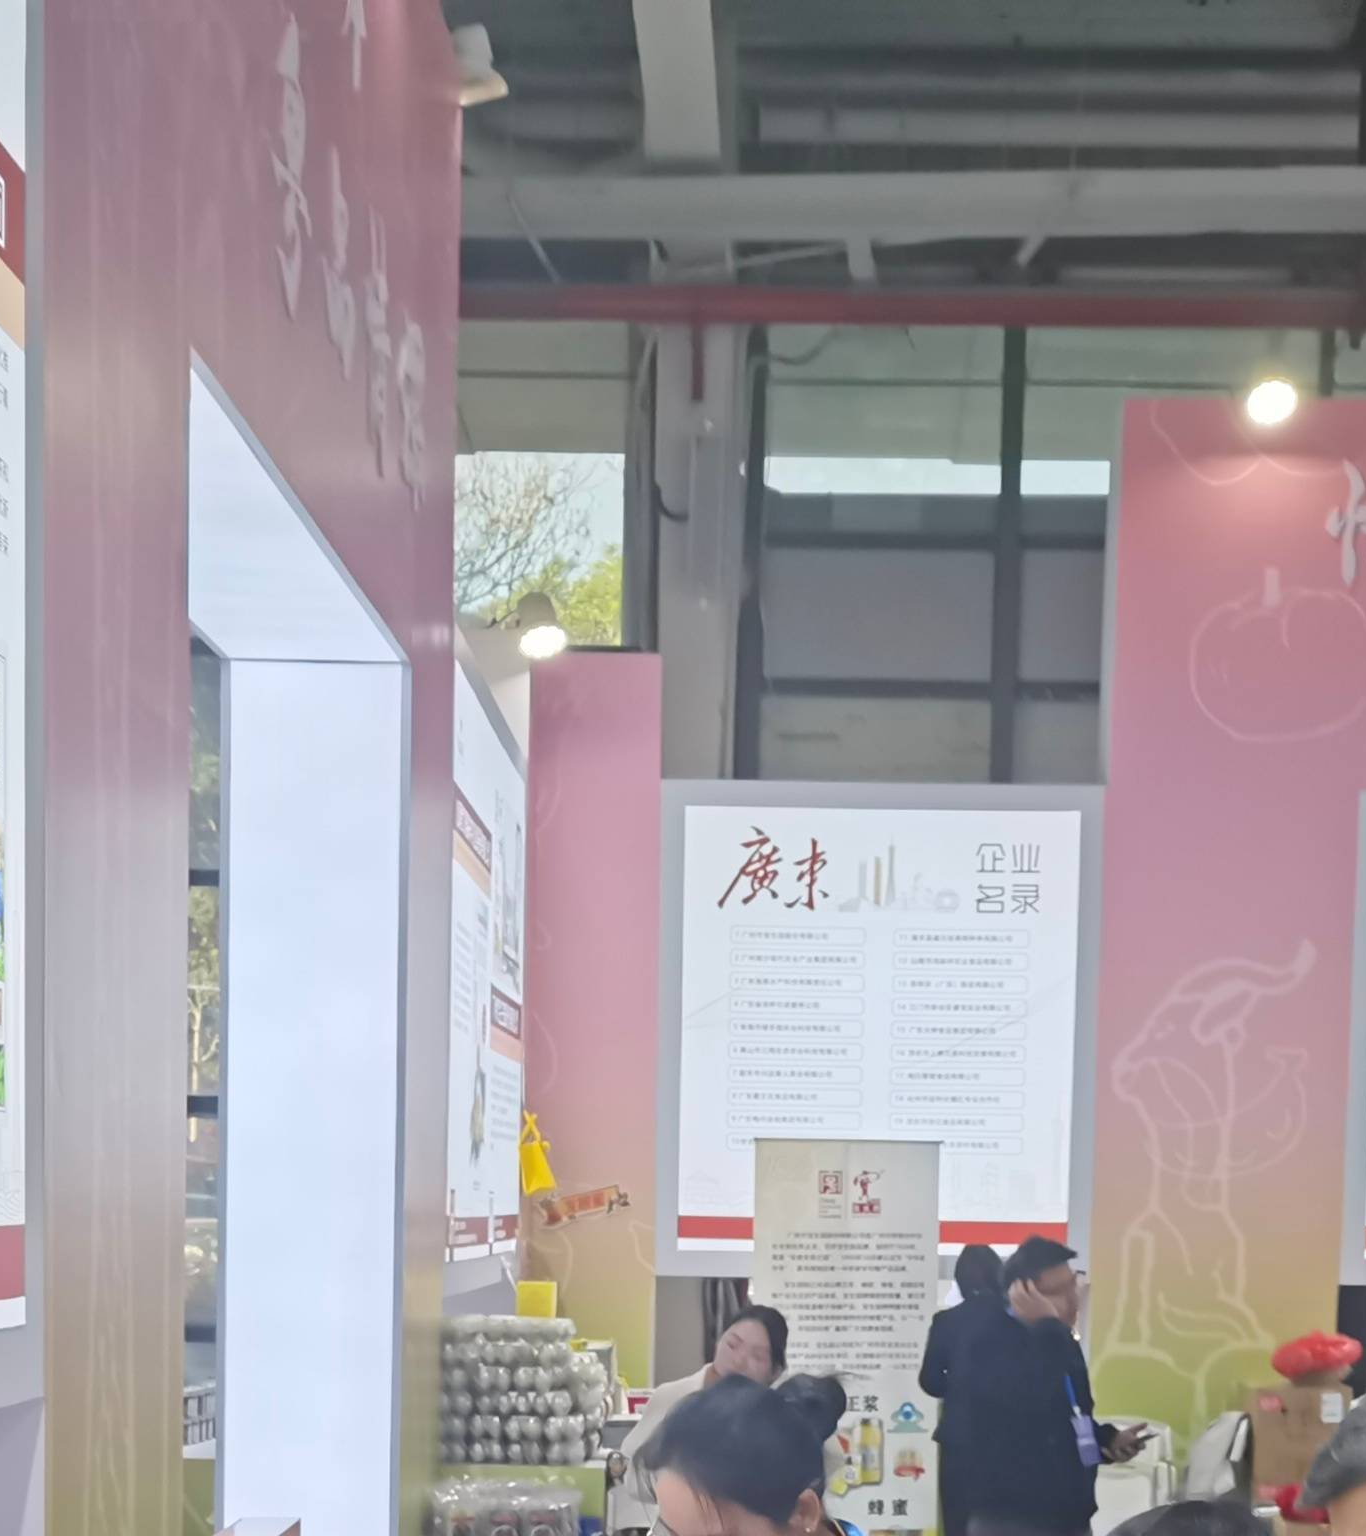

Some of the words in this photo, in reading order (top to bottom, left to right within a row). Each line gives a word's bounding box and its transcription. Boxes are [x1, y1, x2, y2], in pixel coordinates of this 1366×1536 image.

[976, 843, 1041, 875] 企业
[975, 884, 1040, 914] 名录
[867, 1498, 908, 1516] 蜂蜜
